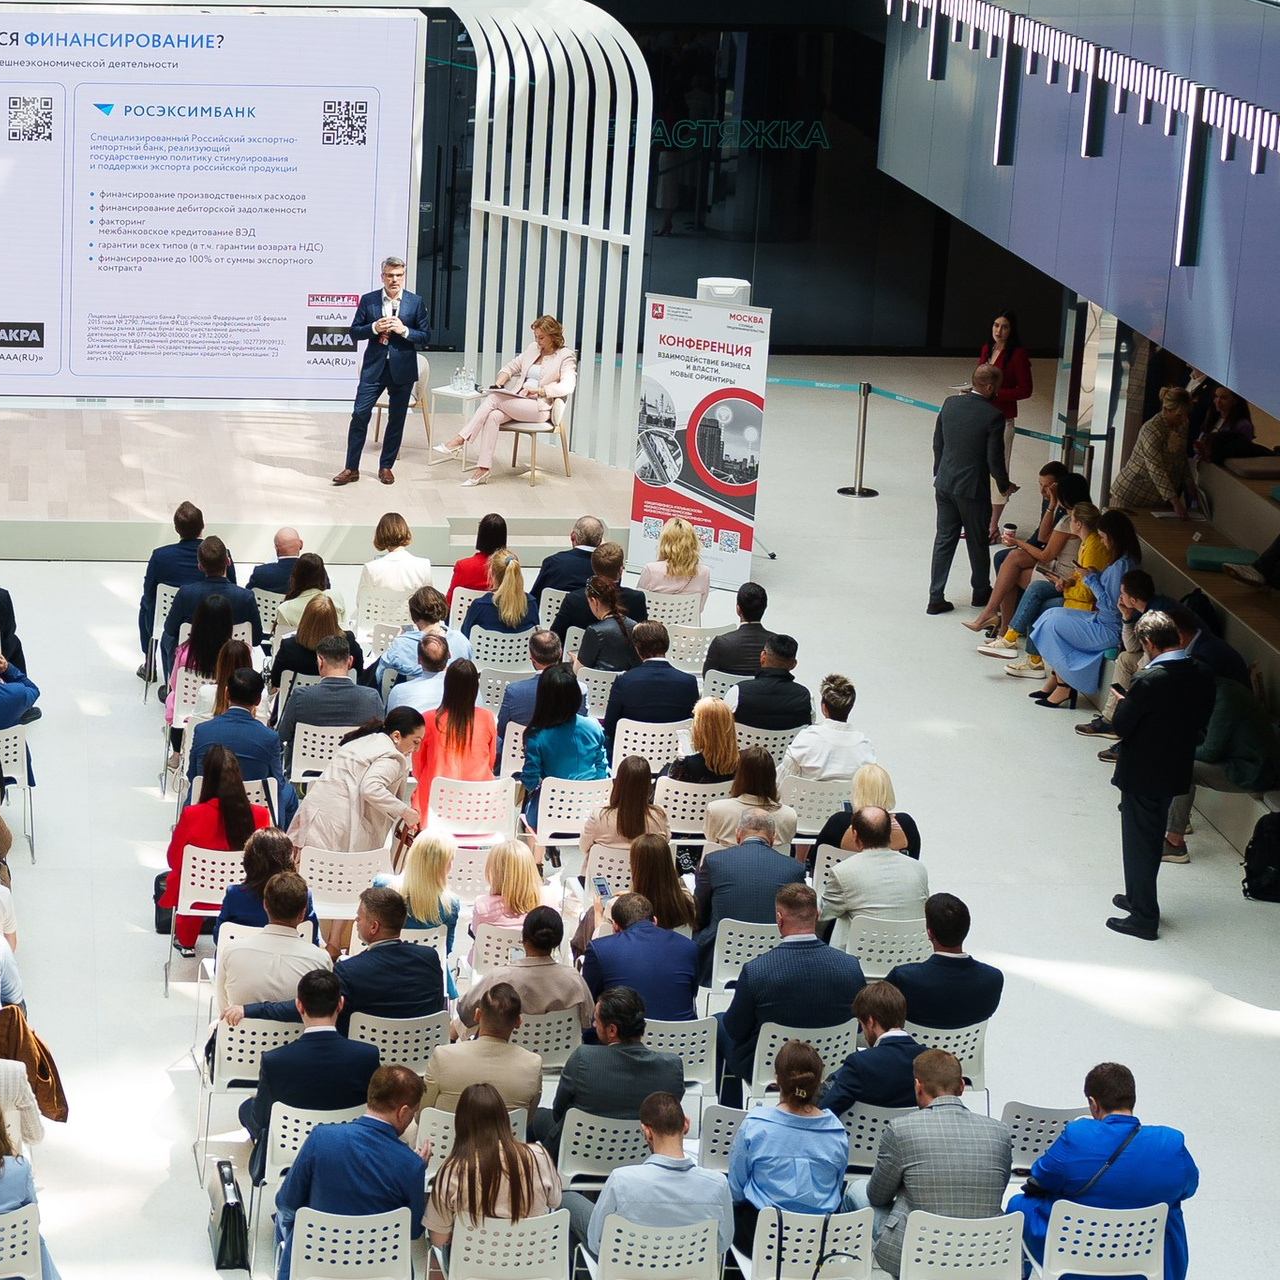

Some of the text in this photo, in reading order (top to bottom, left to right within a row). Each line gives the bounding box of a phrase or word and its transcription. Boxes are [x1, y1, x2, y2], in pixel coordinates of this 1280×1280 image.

[24, 32, 224, 48] ФИНАНСИРОВАНИЕ?
[107, 61, 178, 70] деятельности
[123, 105, 255, 117] РОСЭКСИМБАНК
[90, 133, 298, 145] Специализированный Российский экспортно-
[89, 142, 230, 153] импортный банк, реализующий
[89, 154, 289, 164] государственную политику стимулирования
[97, 164, 148, 172] поддержки
[150, 164, 191, 172] экспорта
[192, 162, 246, 173] российской
[248, 165, 298, 173] продукции
[98, 190, 175, 200] финансирование
[176, 193, 262, 201] производственных
[98, 203, 307, 215] финансирование дебиторской задолженности
[98, 217, 146, 227] факторинг
[98, 226, 256, 238] межбанковское кредитование ВЭД
[98, 242, 138, 251] гарантии
[189, 241, 198, 251] (в
[215, 244, 255, 252] гарантии
[257, 244, 297, 252] возврата
[298, 242, 324, 252] НДС)
[97, 254, 174, 264] финансирование
[189, 255, 212, 263] 100%
[226, 257, 255, 265] суммы
[257, 257, 314, 265] экспортного
[97, 265, 142, 273] контракта
[729, 313, 764, 325] МОСКВА
[310, 333, 354, 346] АКРА
[659, 334, 752, 358] КОНФЕРЕНЦИЯ
[306, 357, 356, 367] «AAA(RU)»
[657, 351, 751, 371] ВЗАИМОДЕЙСТВИЕ БИЗНЕСА
[670, 369, 736, 385] НОВЫЕ ОРИЕНТИРЫ
